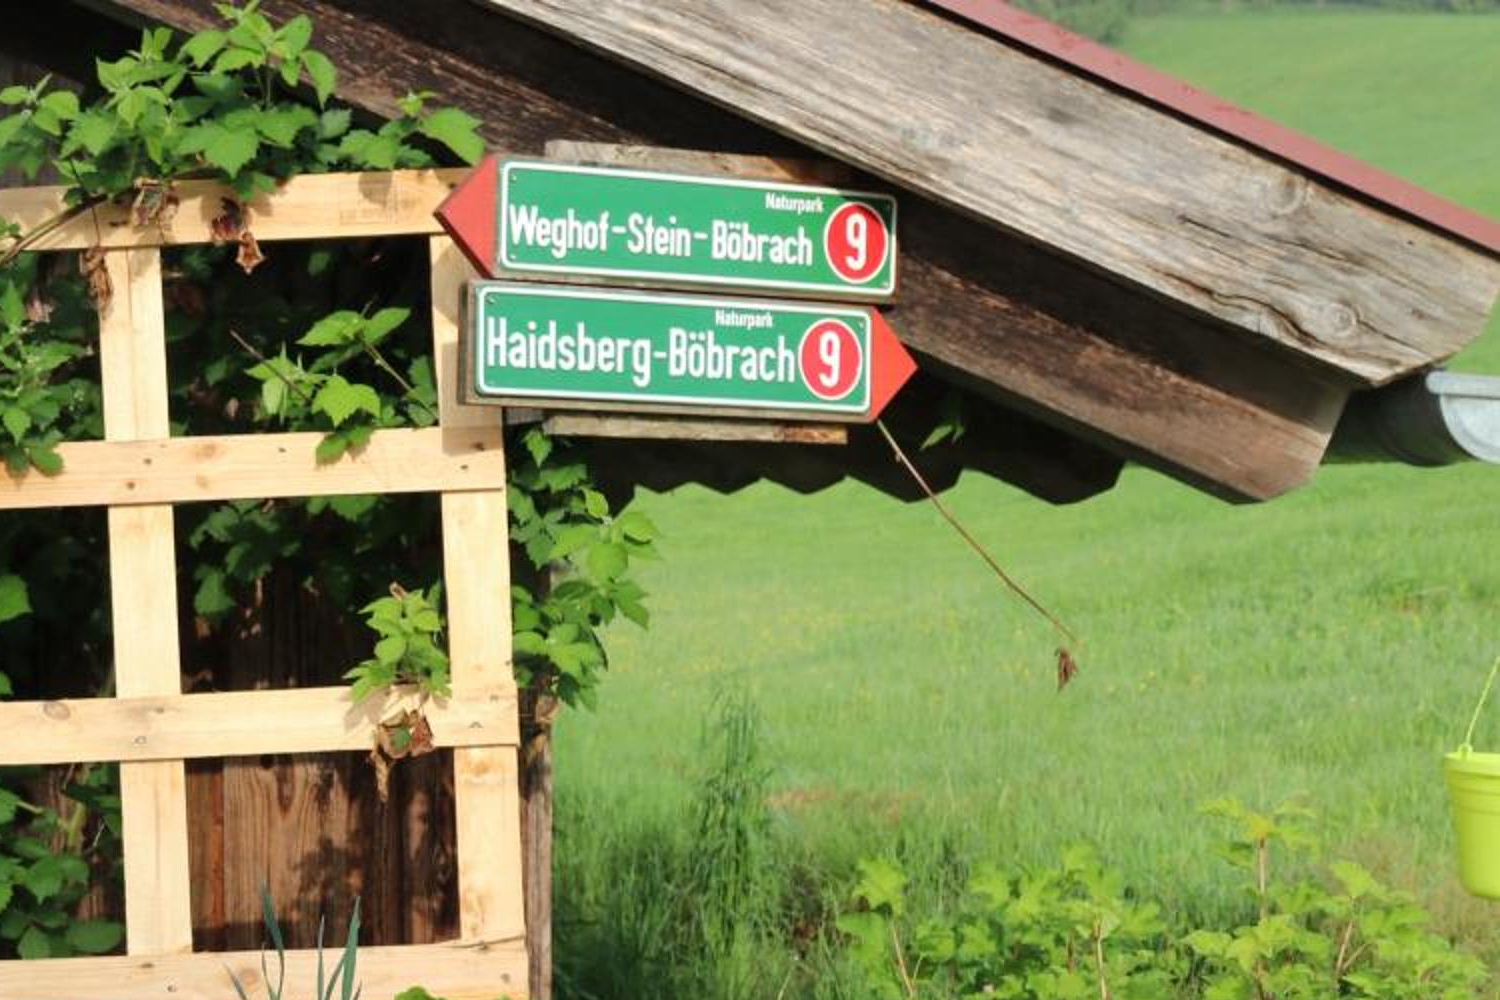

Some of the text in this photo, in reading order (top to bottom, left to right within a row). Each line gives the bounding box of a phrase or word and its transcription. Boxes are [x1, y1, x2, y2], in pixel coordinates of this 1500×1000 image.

[765, 192, 823, 213] Naturpark
[846, 214, 867, 271] 9
[715, 309, 773, 329] Naturpark
[486, 316, 841, 388] Haidsberg-Böbrach 9
